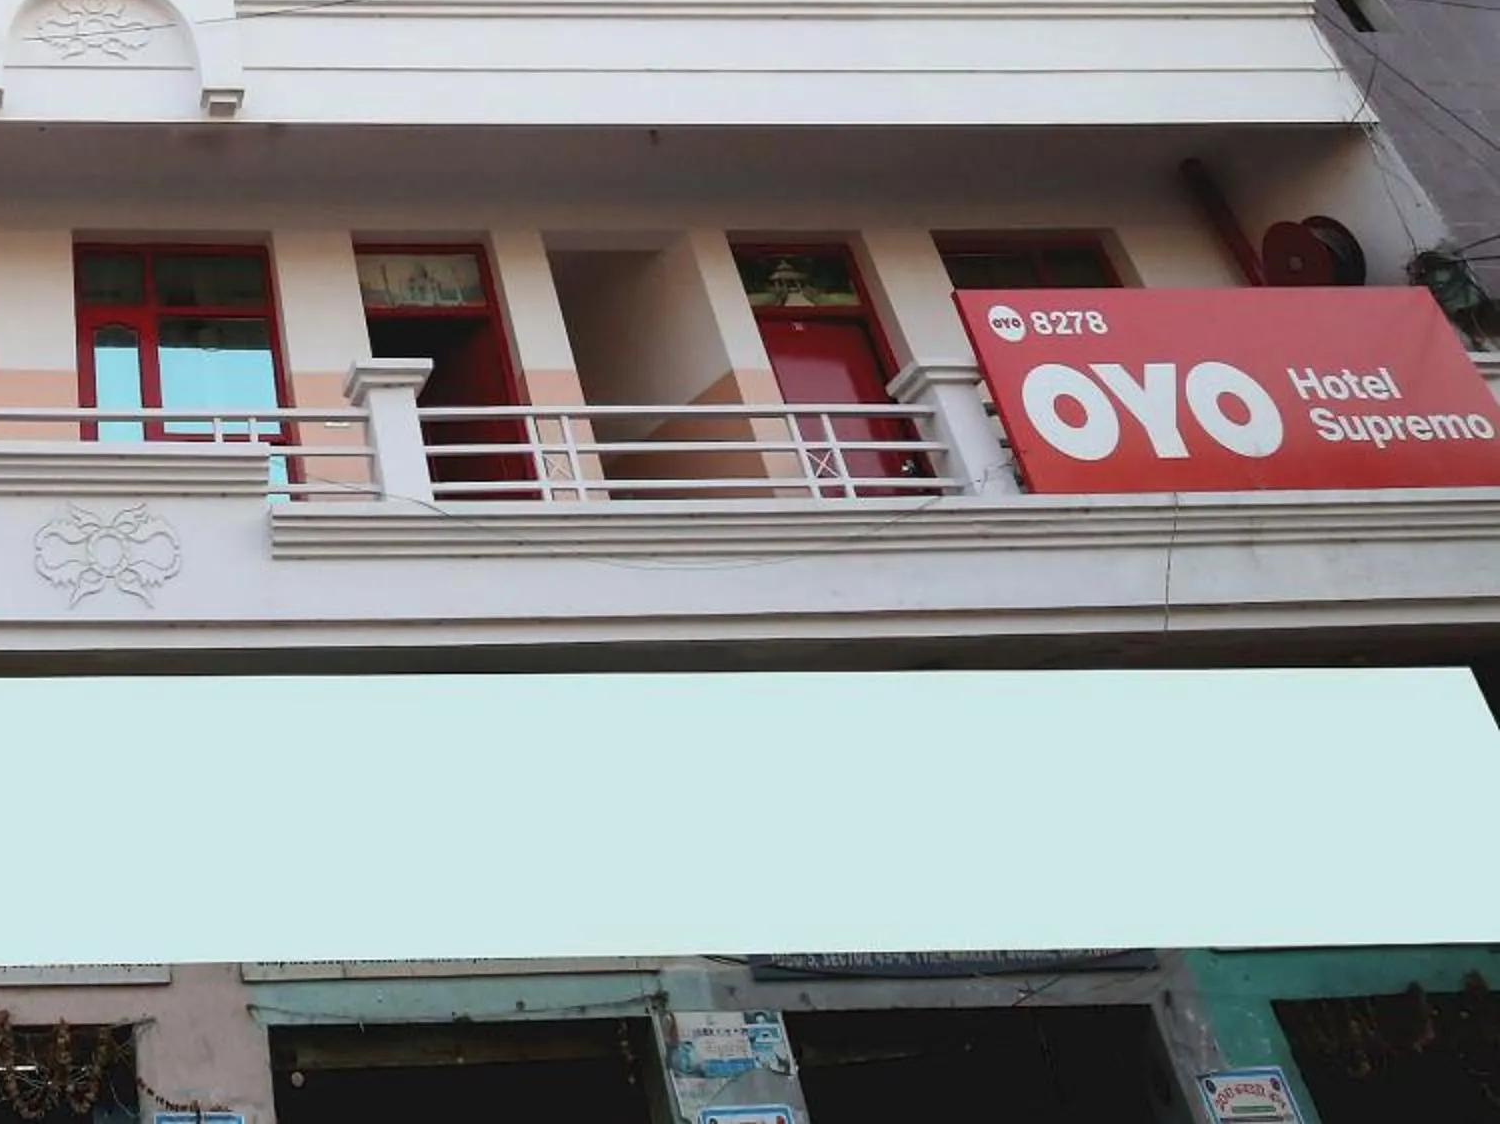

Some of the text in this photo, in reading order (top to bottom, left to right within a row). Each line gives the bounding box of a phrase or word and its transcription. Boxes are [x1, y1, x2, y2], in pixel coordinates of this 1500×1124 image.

[992, 311, 1109, 335] OYO 8278
[1286, 367, 1402, 401] Hotel
[1021, 361, 1284, 461] OYO
[1308, 406, 1496, 449] Supremo
